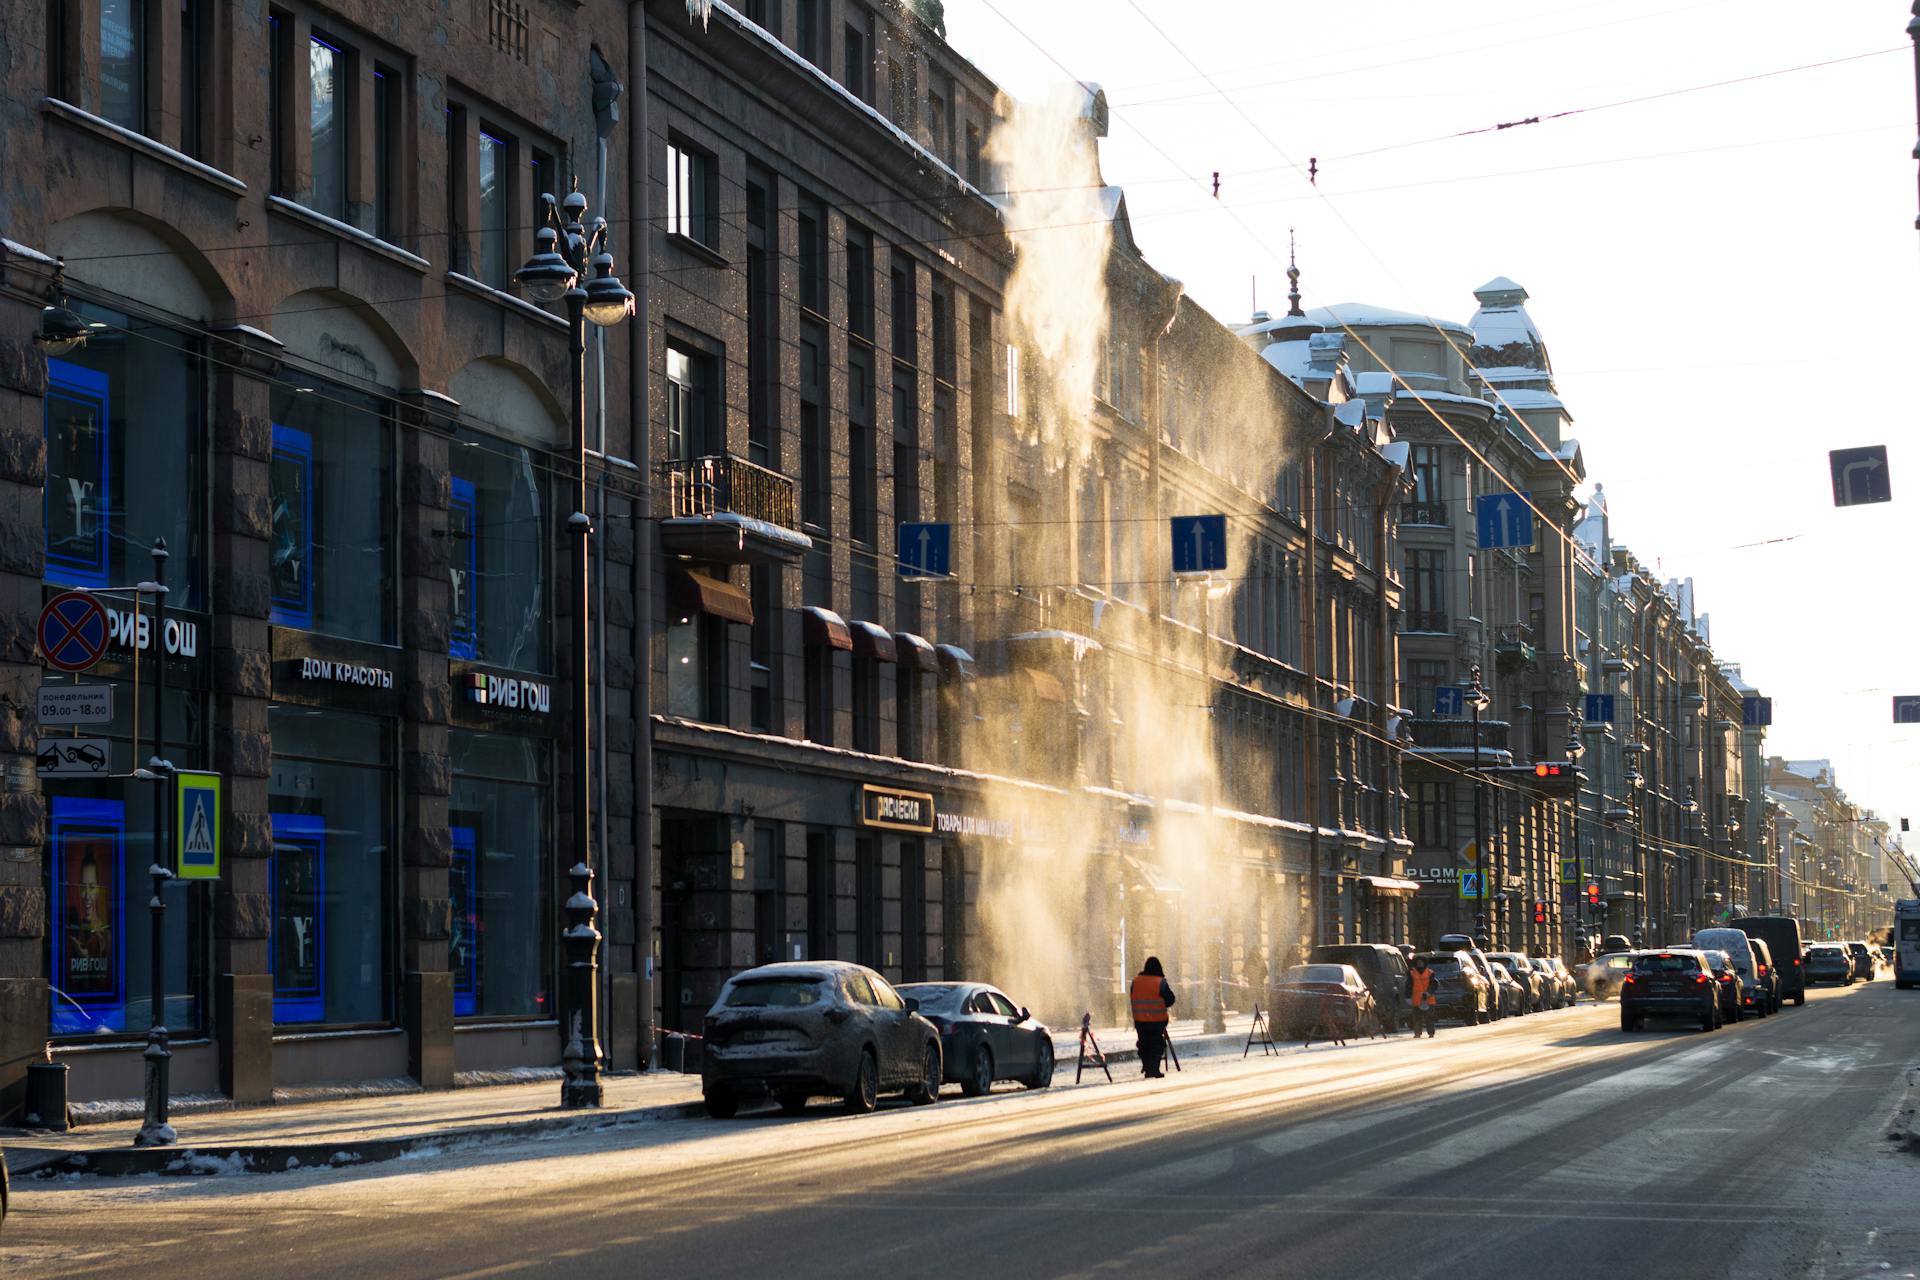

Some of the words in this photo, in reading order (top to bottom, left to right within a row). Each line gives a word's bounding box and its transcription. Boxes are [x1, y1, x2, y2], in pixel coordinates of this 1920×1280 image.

[302, 657, 332, 680] ДОМ
[335, 663, 393, 689] КРАСОТЫ
[43, 694, 105, 702] понедельник
[488, 675, 519, 709] РИВ
[520, 680, 550, 713] ГОШ
[936, 813, 962, 832] ТОВАРЫ
